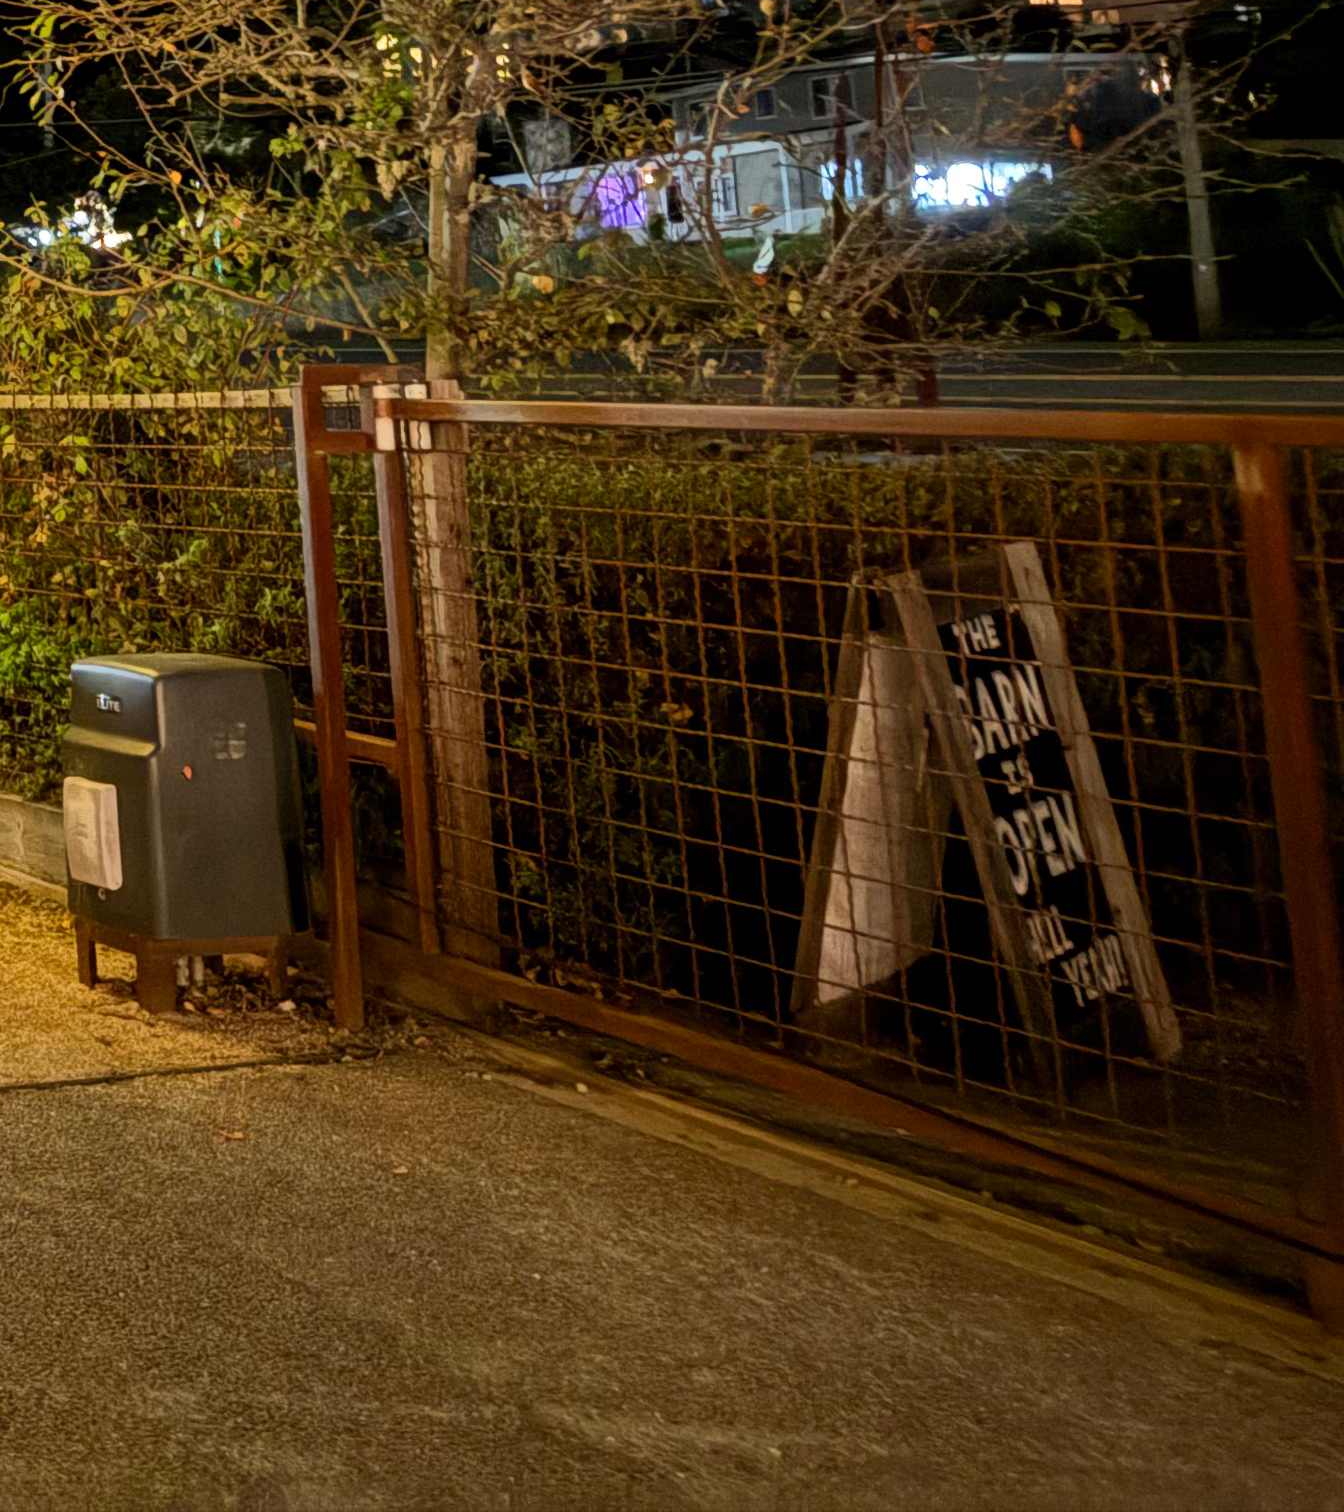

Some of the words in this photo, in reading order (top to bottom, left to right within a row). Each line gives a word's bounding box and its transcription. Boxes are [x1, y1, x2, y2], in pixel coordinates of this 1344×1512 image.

[951, 613, 1001, 656] THE
[953, 662, 1053, 761] BARN
[1000, 752, 1034, 795] IS
[995, 791, 1087, 896] OPEN
